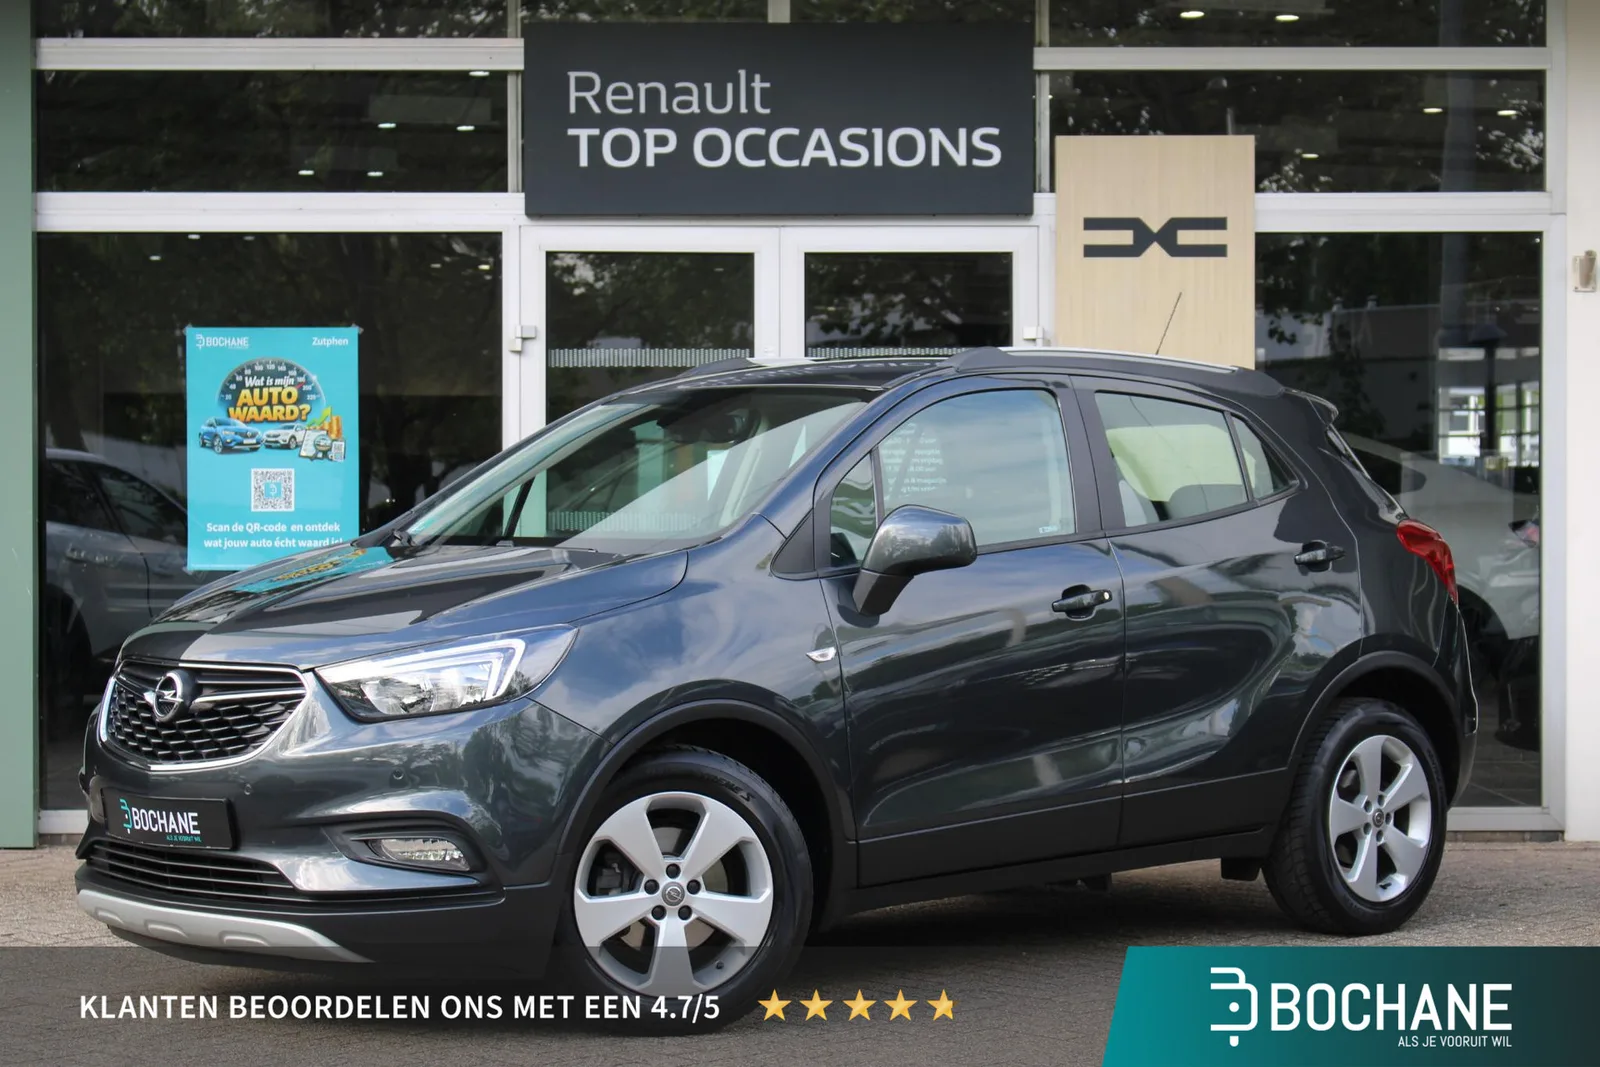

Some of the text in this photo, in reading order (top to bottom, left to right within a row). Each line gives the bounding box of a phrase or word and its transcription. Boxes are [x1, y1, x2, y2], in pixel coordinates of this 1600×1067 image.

[567, 69, 771, 115] Renault
[567, 127, 1002, 168] TOP OCCASIONS
[206, 336, 249, 347] BOCHANE
[312, 336, 349, 348] Zutphen
[244, 376, 295, 388] Wat is mijn
[236, 386, 298, 407] AUTO
[228, 404, 312, 423] WAARD?
[206, 522, 340, 534] Scan de QR-code en ontdek
[203, 539, 222, 548] wat
[224, 538, 249, 550] jouw
[250, 539, 272, 548] auto
[274, 537, 296, 548] écht
[298, 538, 327, 548] waard
[131, 807, 201, 834] BOCHANE
